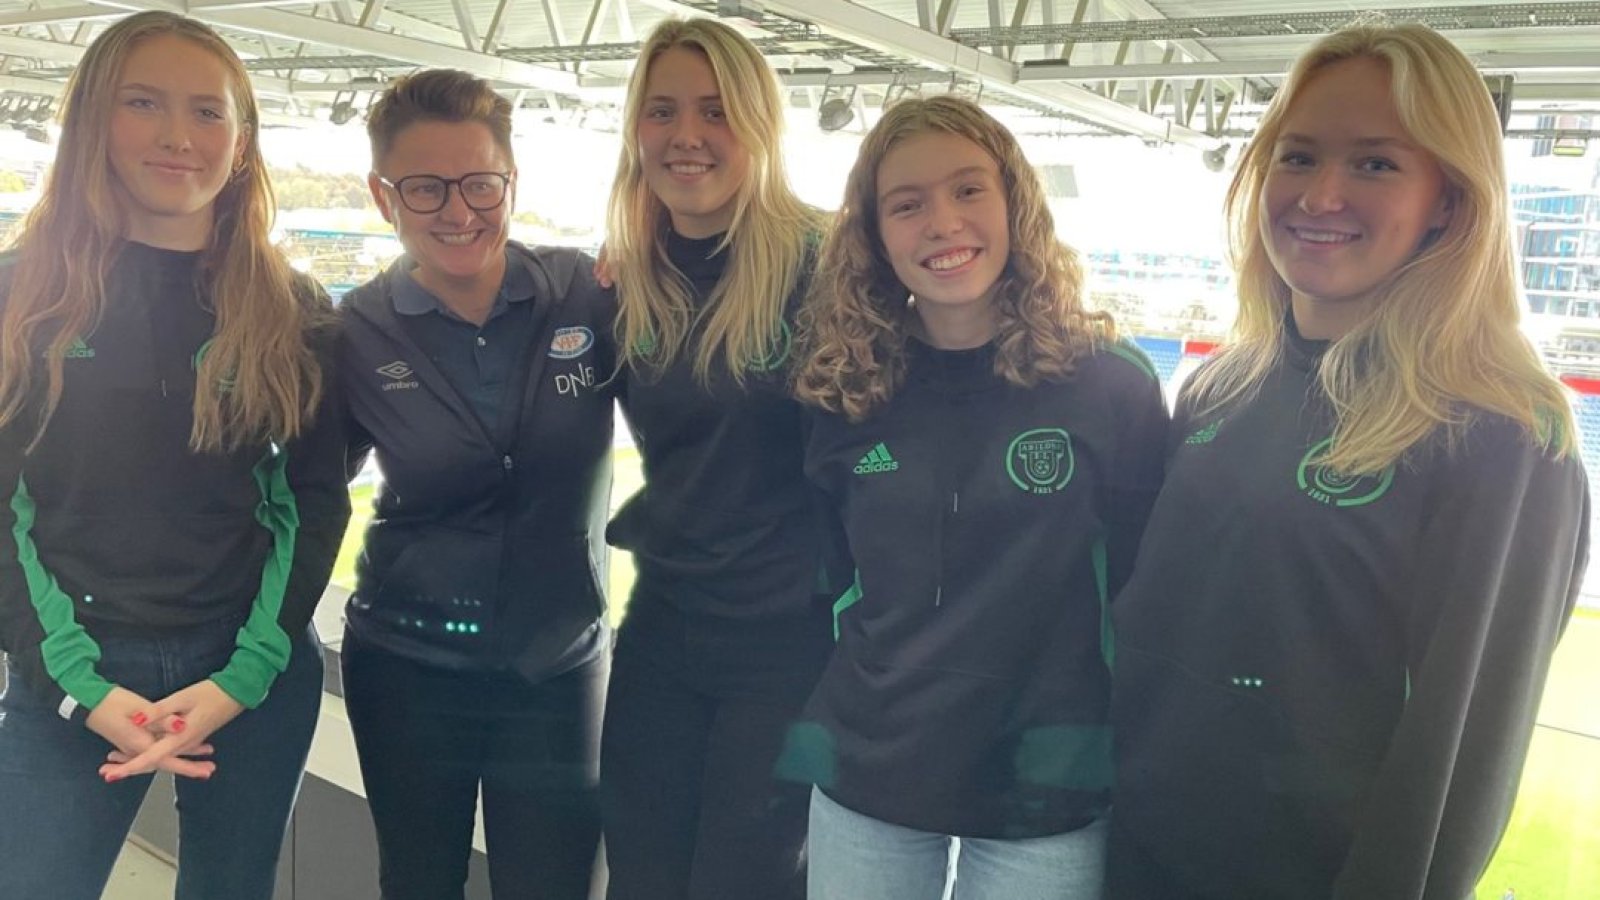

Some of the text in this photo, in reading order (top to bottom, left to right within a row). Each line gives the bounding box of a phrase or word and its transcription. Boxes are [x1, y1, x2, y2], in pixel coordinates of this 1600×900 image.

[43, 347, 96, 358] adas
[382, 380, 419, 392] umbro
[555, 363, 595, 398] DNB
[853, 461, 899, 475] adidas
